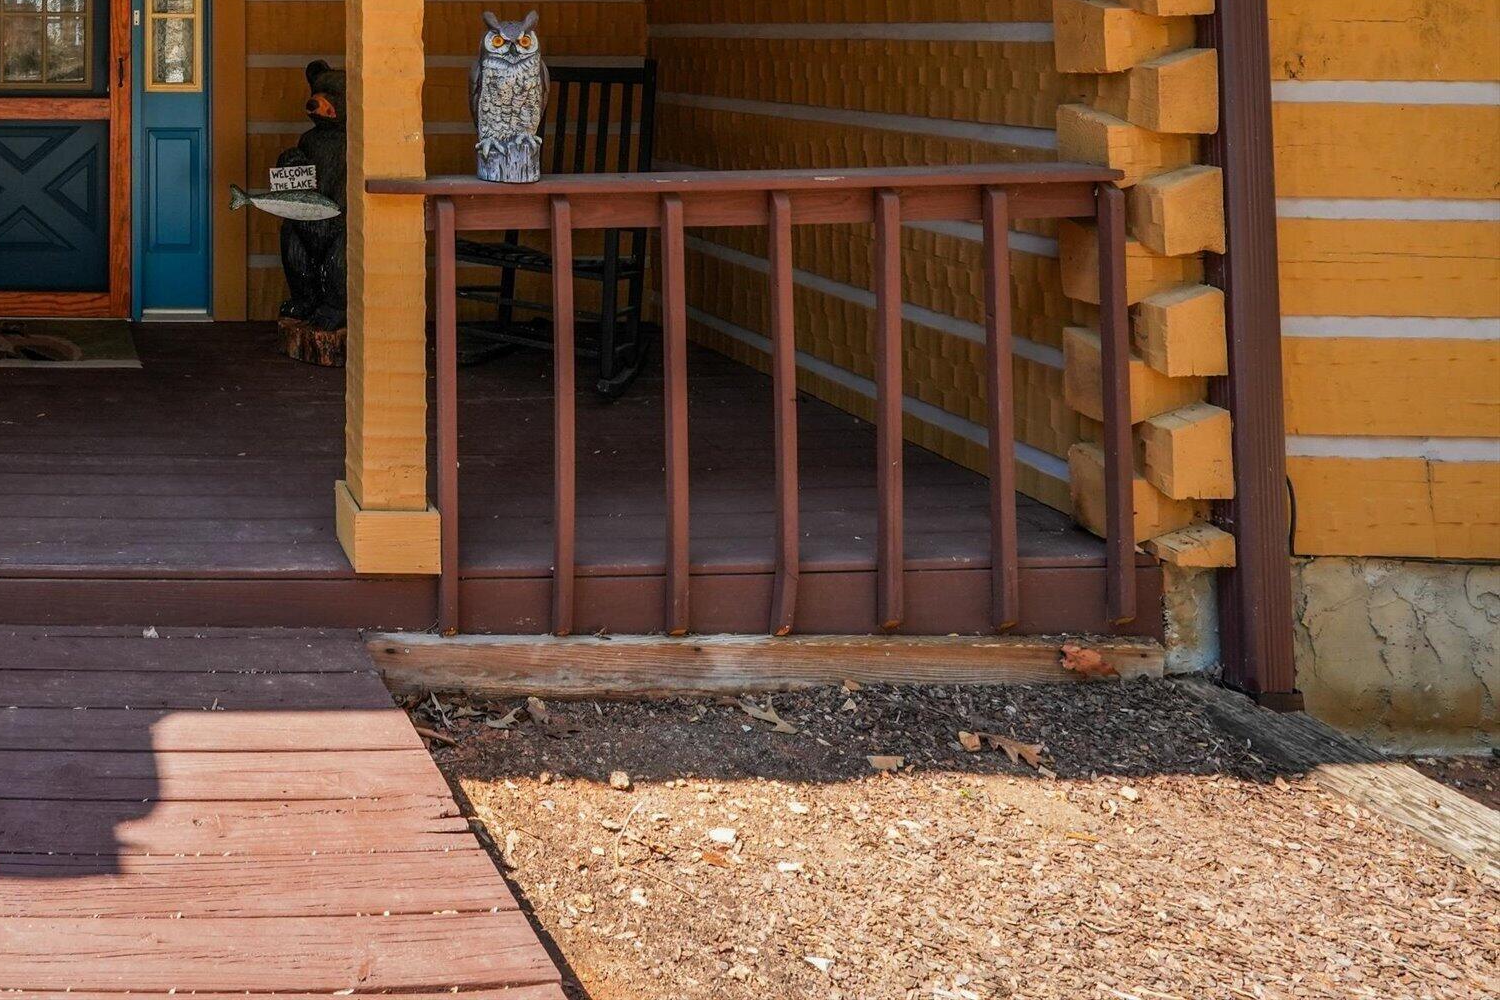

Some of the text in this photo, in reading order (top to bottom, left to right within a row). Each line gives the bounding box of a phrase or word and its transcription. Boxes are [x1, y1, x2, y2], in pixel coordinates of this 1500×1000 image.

[271, 166, 314, 179] WELCOME
[273, 179, 313, 190] THE LAKE
